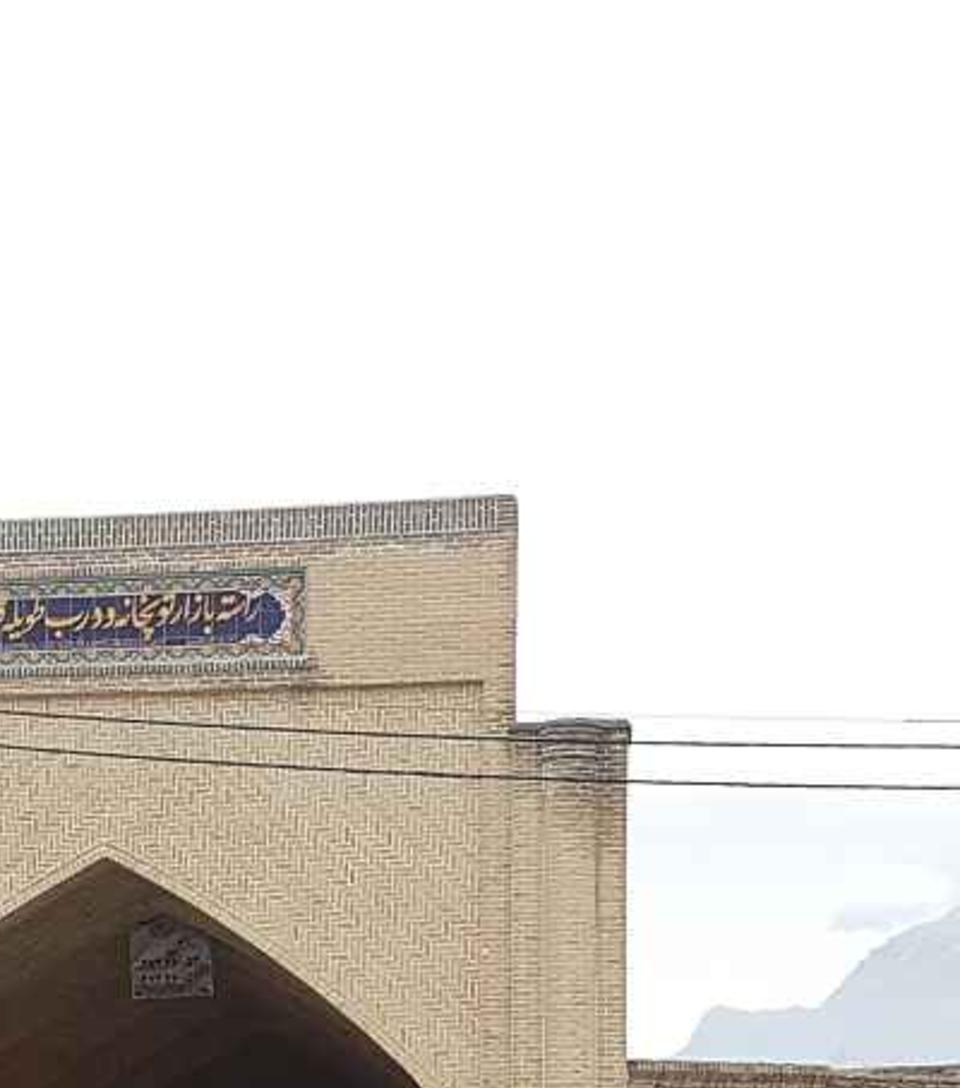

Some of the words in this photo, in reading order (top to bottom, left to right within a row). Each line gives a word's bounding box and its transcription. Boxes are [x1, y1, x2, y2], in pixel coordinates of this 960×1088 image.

[45, 606, 102, 638] درب
[114, 593, 176, 641] توپخانه
[170, 593, 215, 634] بازار
